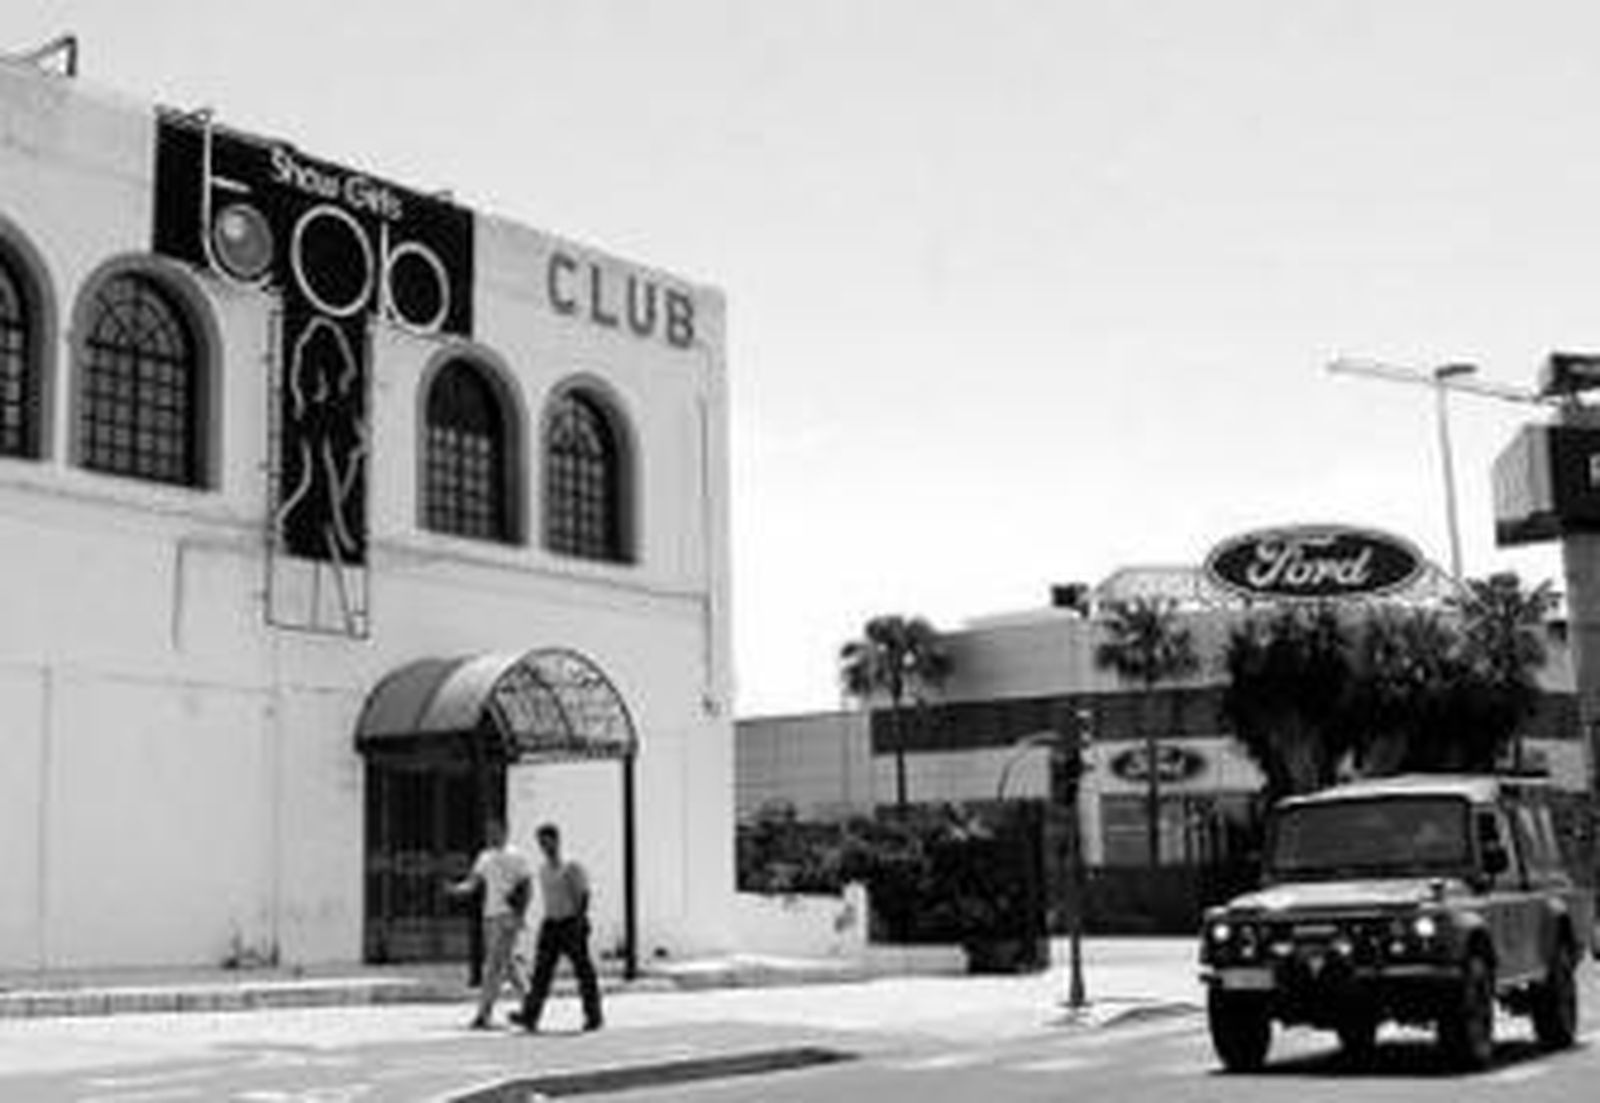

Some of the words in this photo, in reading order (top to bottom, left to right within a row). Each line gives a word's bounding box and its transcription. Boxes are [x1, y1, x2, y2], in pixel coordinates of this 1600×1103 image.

[269, 146, 340, 199] Show
[547, 252, 695, 350] CLUB
[1247, 540, 1374, 587] Ford
[1126, 748, 1186, 776] Frd
